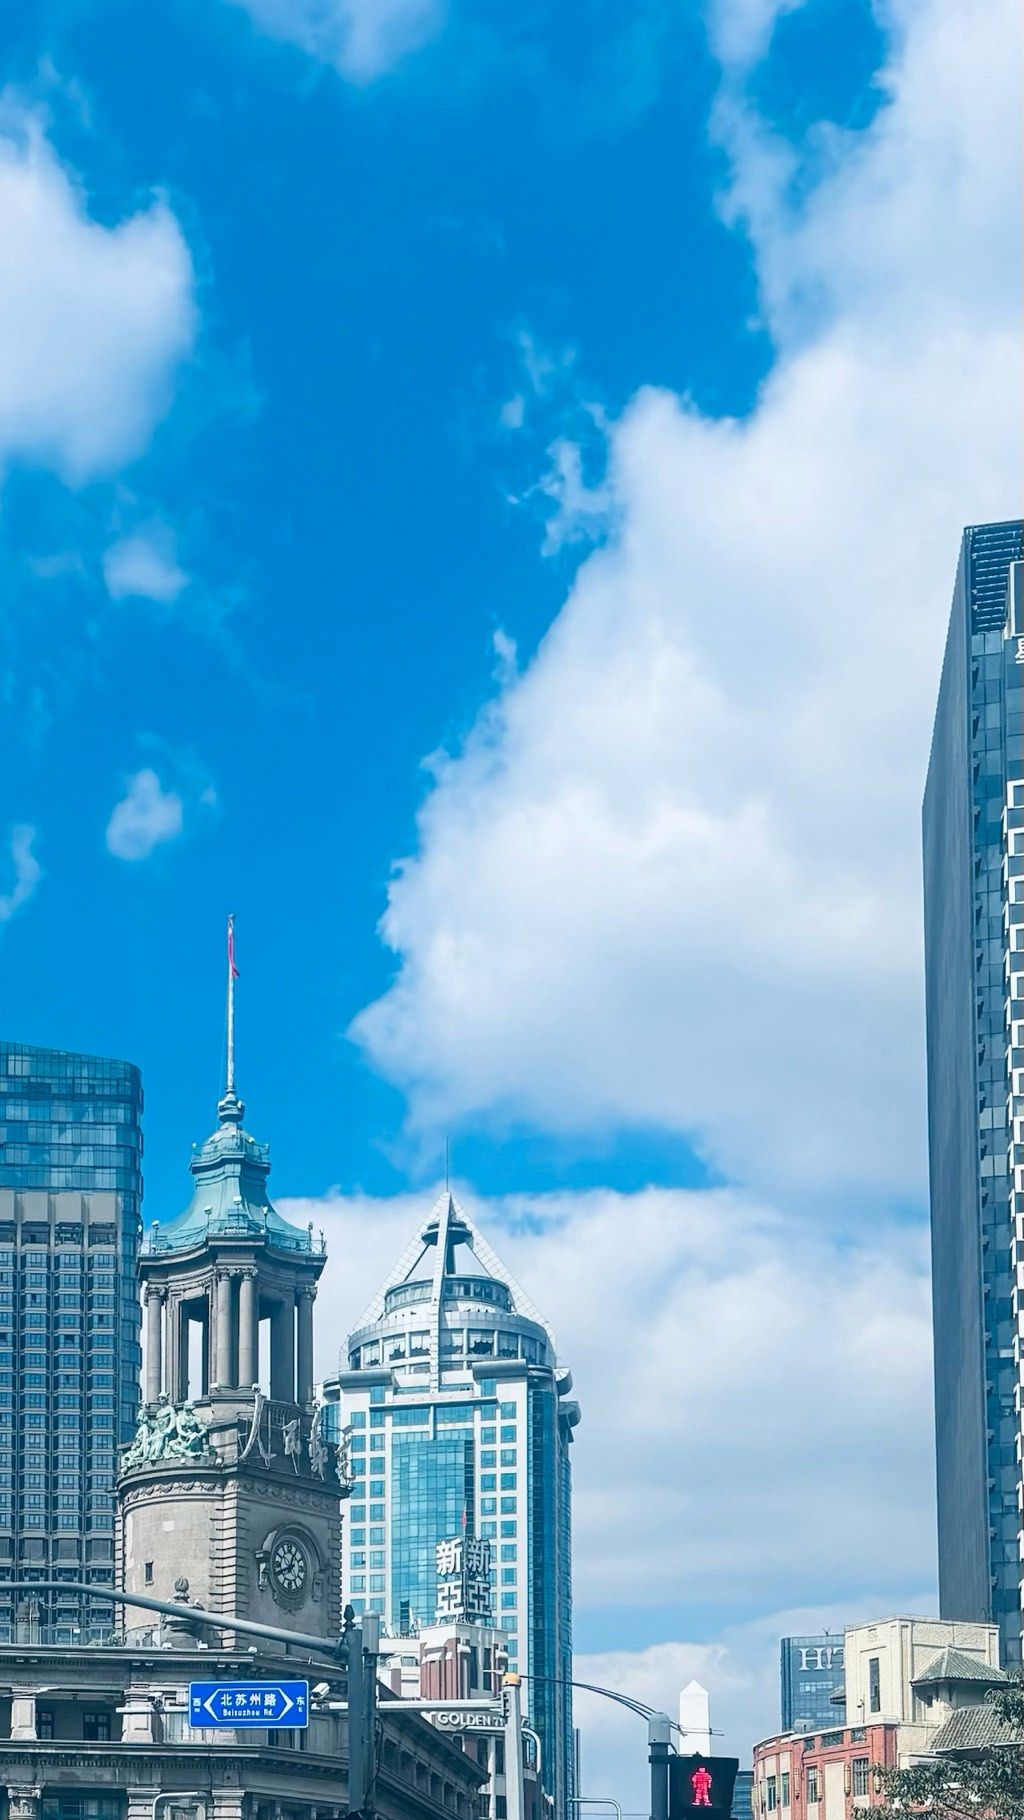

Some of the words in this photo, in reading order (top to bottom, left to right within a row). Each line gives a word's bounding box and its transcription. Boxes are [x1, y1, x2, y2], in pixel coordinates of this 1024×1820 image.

[220, 1692, 276, 1707] 北苏州路
[297, 1695, 305, 1706] 东
[222, 1708, 260, 1717] Beisuzhou
[263, 1708, 275, 1717] Rd.
[437, 1711, 491, 1726] GOLDEN
